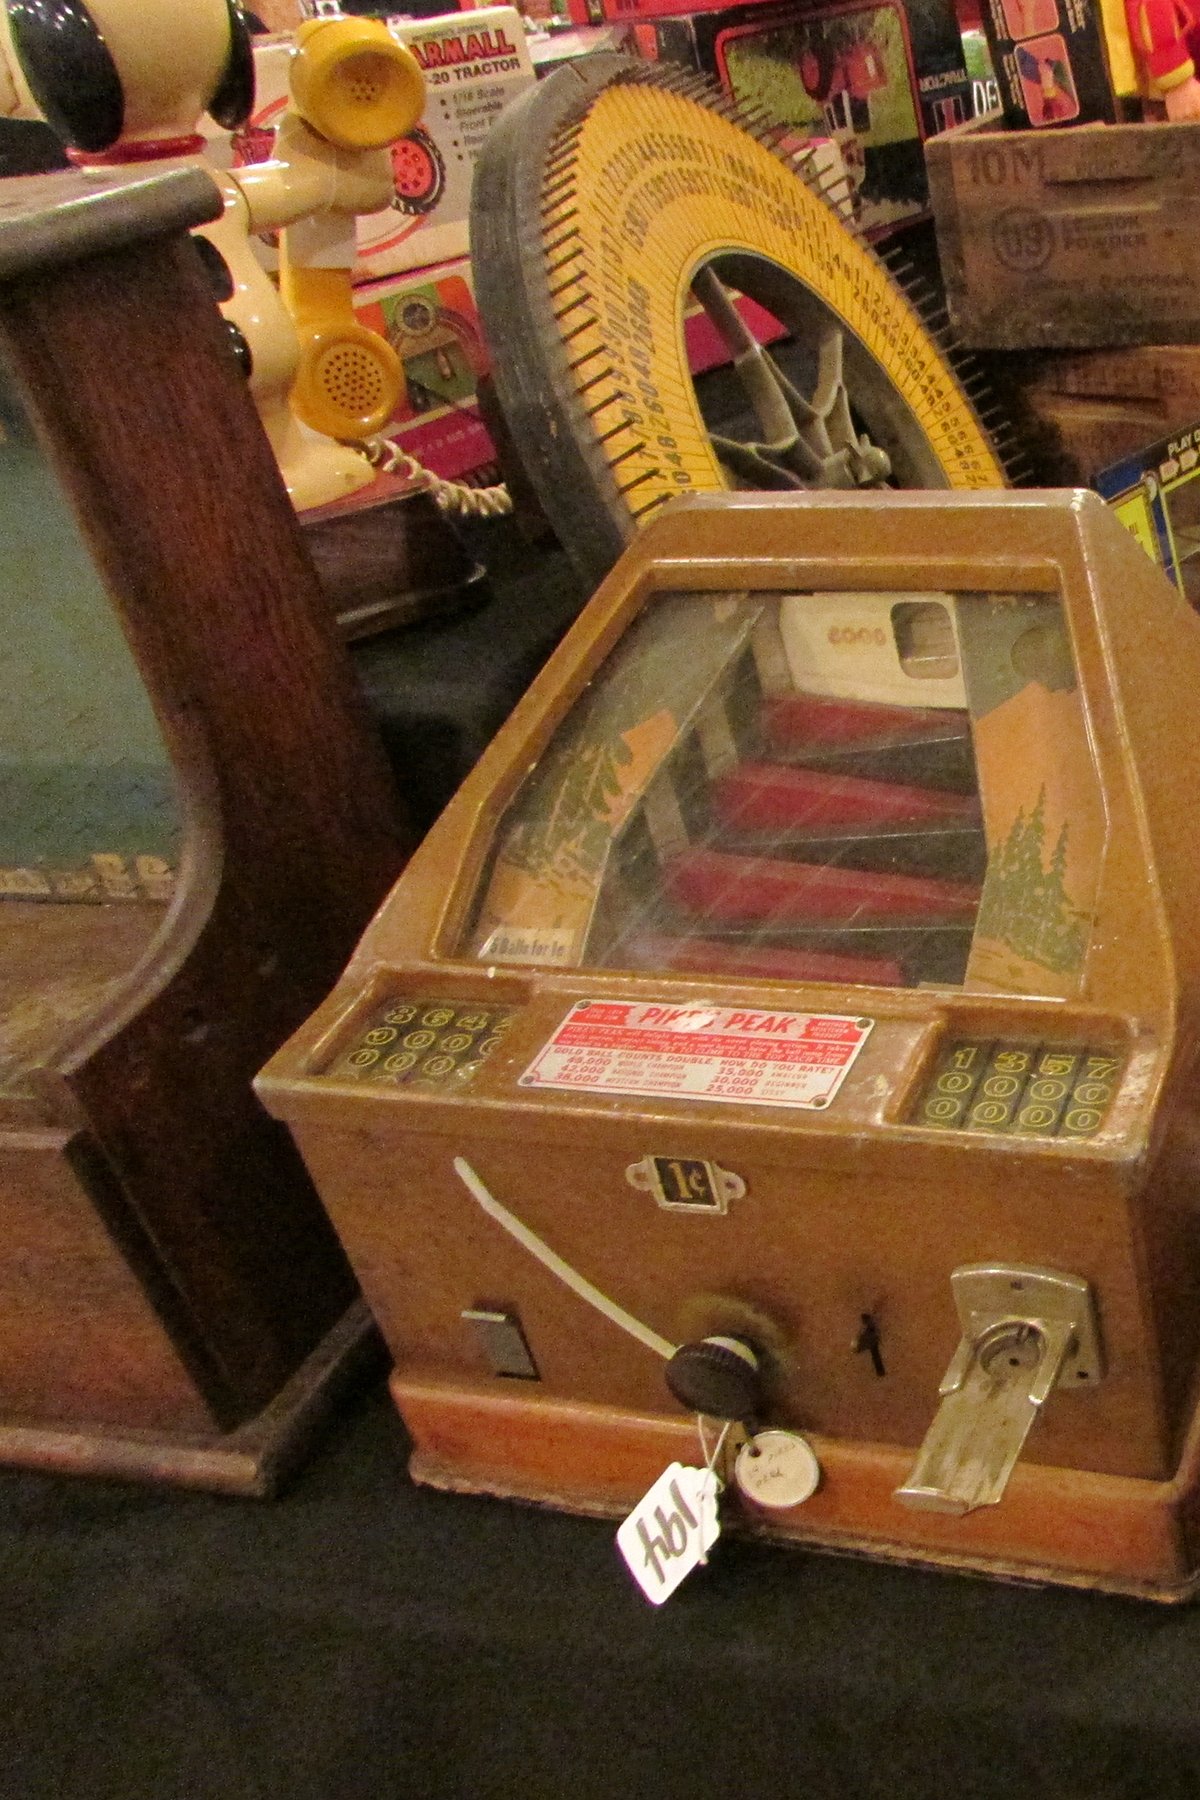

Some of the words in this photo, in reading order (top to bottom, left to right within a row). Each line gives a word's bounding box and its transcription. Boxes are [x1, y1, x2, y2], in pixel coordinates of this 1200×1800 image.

[409, 29, 516, 70] ARMALL
[453, 57, 521, 81] TRACTOR
[1166, 434, 1192, 456] PLAY
[723, 1012, 798, 1035] PEAK
[552, 1047, 584, 1055] GOLD
[585, 1049, 616, 1057] BALL
[616, 1051, 664, 1061] COUNTS
[718, 1059, 747, 1067] HOW
[798, 1064, 835, 1073] RATE?
[703, 1084, 755, 1095] 25,000
[635, 1476, 700, 1586] 194
